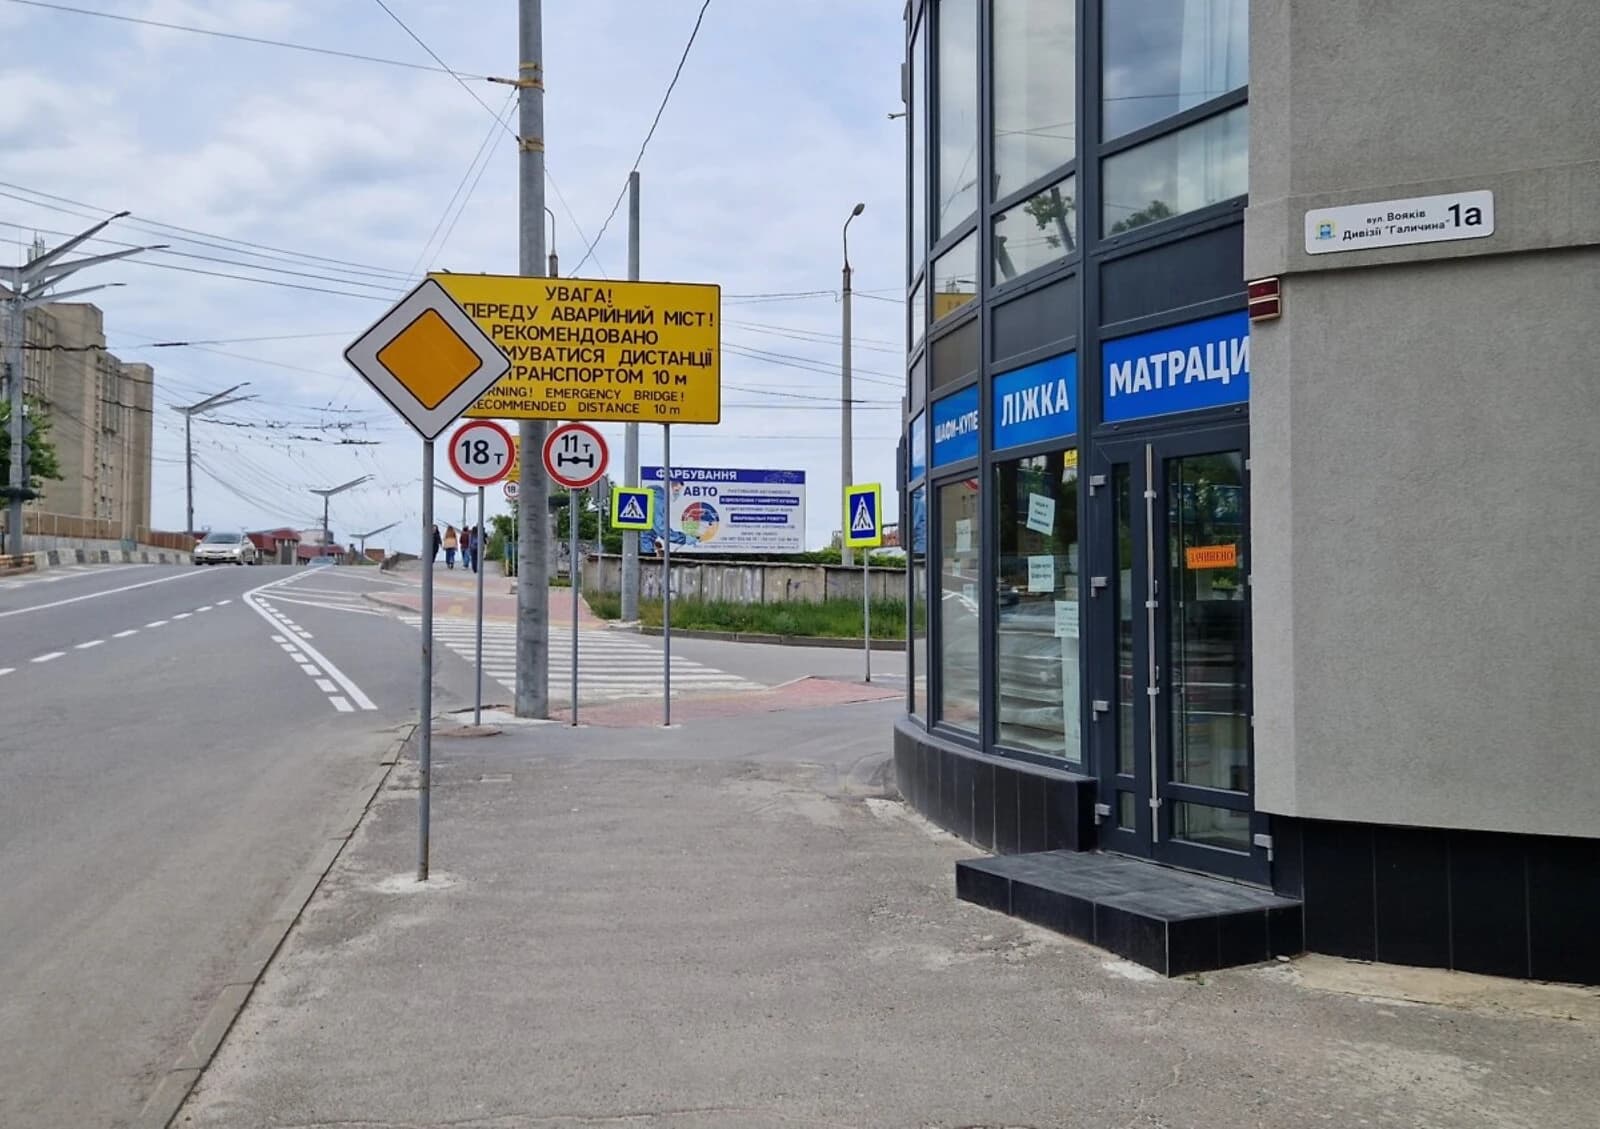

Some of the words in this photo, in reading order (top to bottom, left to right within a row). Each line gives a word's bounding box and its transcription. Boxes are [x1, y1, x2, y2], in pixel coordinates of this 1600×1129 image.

[1387, 209, 1426, 222] Вояків
[1342, 227, 1382, 241] Дивізії
[1385, 219, 1450, 236] "Галичина"
[545, 286, 612, 304] УВАГА!
[463, 303, 538, 322] ПЕРЕДУ
[551, 305, 654, 325] АВАРІЙНИЙ
[492, 324, 658, 346] РЕКОМЕНДОВАНО
[501, 345, 605, 363] МУВАТИСЯ
[619, 348, 713, 369] ДИСТАНЦІЇ
[1109, 336, 1250, 397] МАТРАЦИ
[652, 370, 669, 385] 10
[674, 375, 687, 385] м
[487, 386, 533, 398] RNING!
[545, 387, 621, 400] EMERGENCY
[1001, 378, 1070, 428] ЛІЖКА
[472, 399, 566, 412] ECOMMENDED
[578, 401, 639, 414] DISTANCE
[654, 403, 667, 414] 10
[669, 405, 680, 415] m
[935, 410, 979, 444] ШАФИ-КУПЕ
[461, 439, 489, 465] 18
[561, 434, 578, 453] 11
[656, 469, 737, 481] ФАРБУВАННЯ
[683, 486, 718, 497] АВТО
